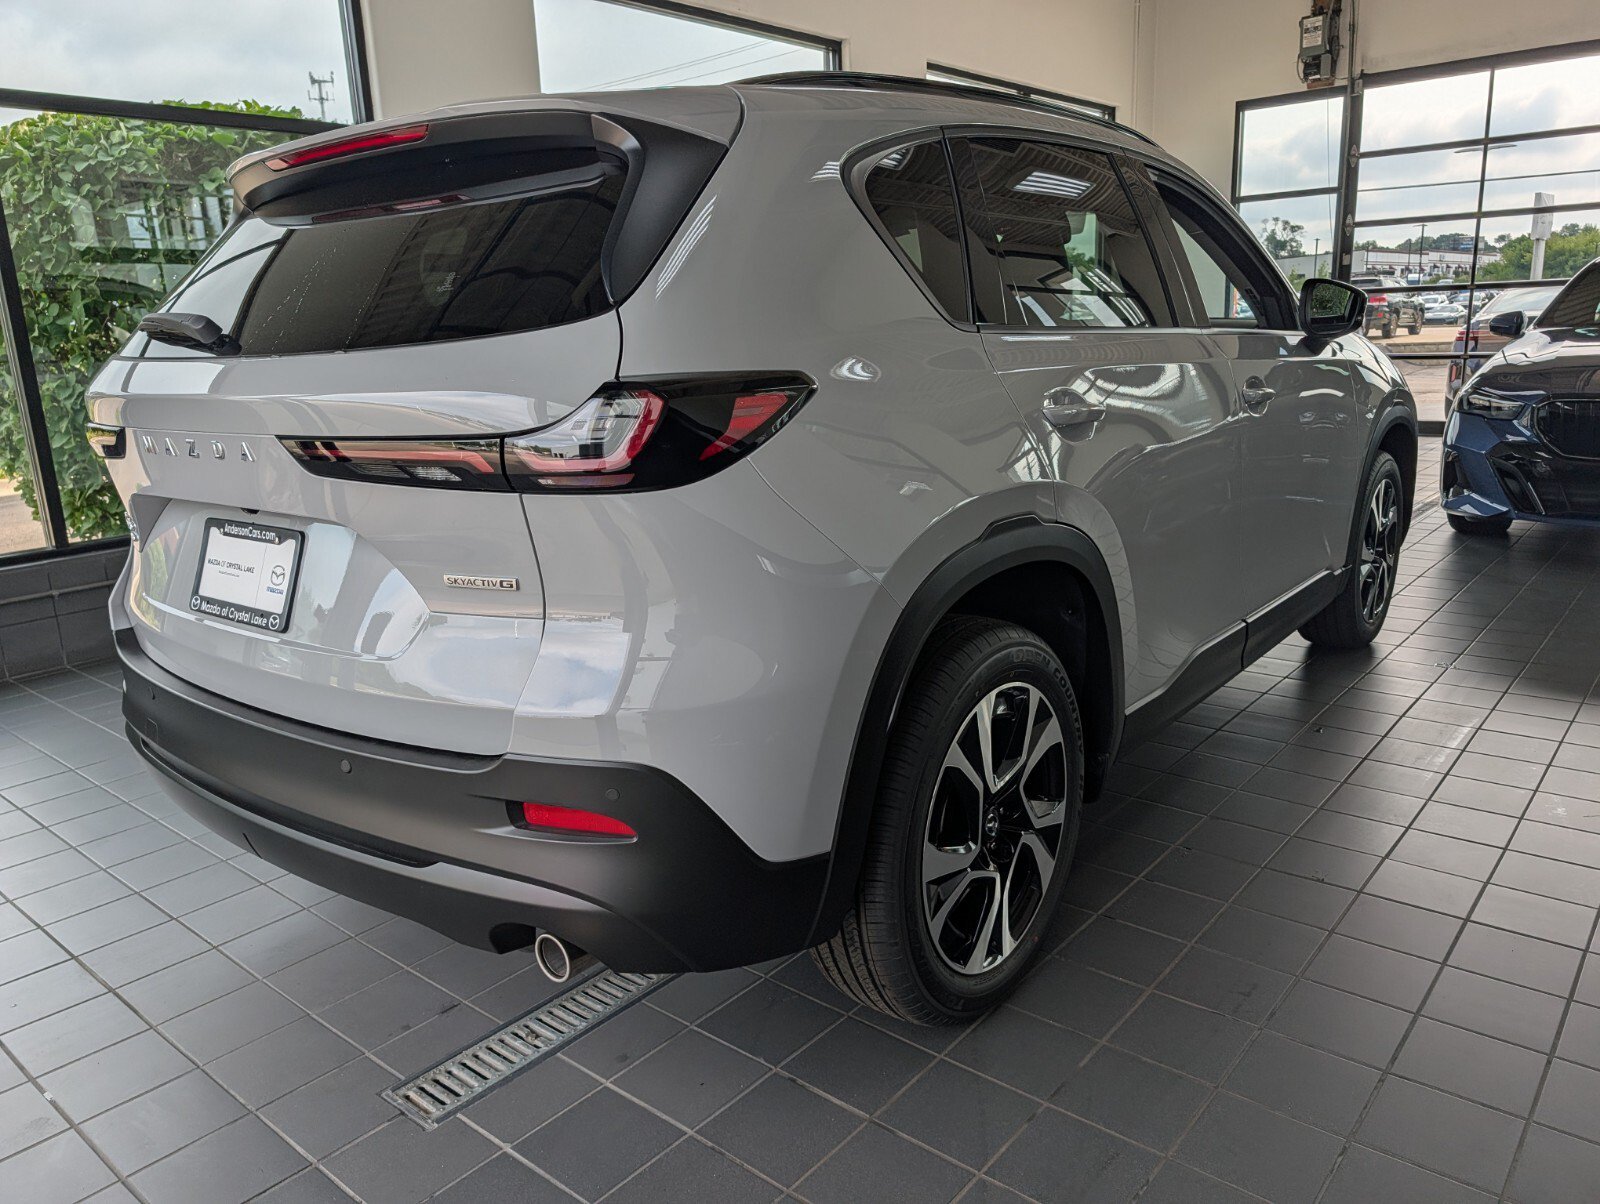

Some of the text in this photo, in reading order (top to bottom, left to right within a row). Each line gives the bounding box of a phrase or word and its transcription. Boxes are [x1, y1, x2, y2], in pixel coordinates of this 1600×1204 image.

[142, 436, 257, 462] MAZDA
[225, 523, 276, 540] AndersonCars.com
[244, 565, 255, 573] LAKE
[201, 600, 267, 626] Mazda of Crystal Lake
